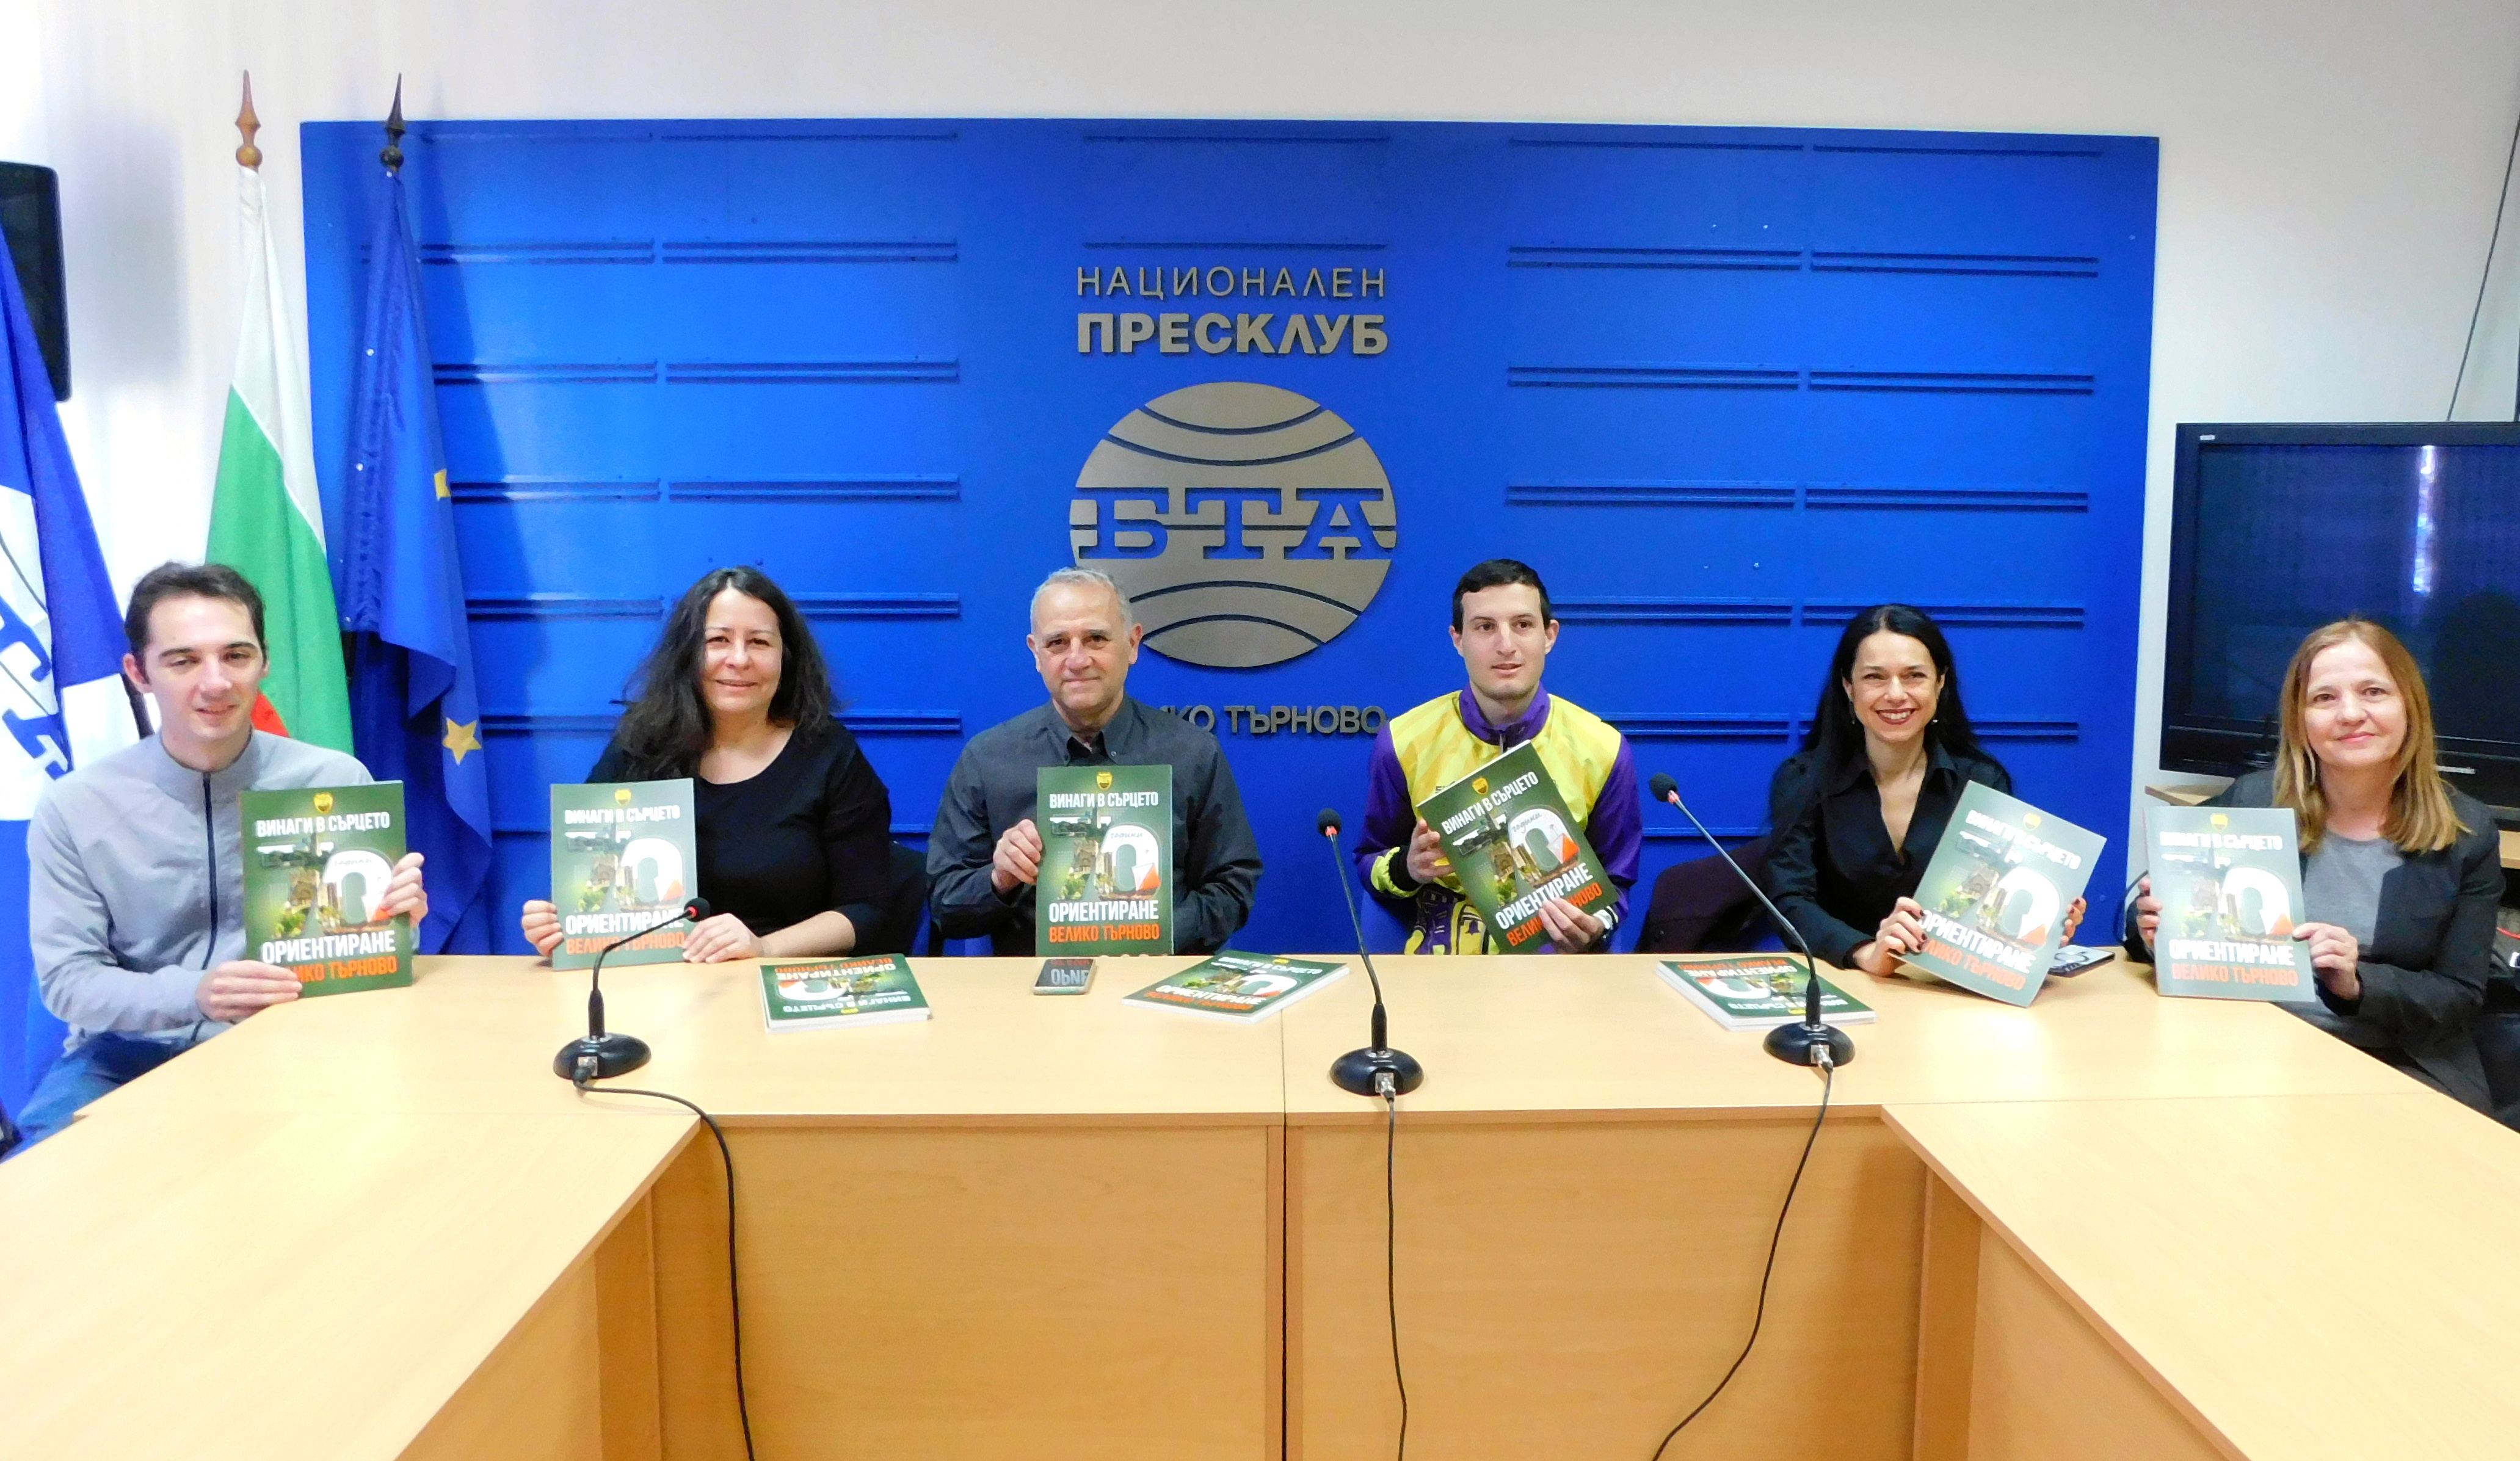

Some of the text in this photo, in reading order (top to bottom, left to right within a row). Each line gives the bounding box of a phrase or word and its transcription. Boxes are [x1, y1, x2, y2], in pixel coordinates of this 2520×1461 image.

[1077, 266, 1385, 300] НАЦИОНАЛЕН
[1077, 312, 1389, 355] ПРЕСКЛУБ
[1076, 487, 1395, 560] БТА
[1224, 705, 1387, 734] ТЪРНОВО
[1049, 791, 1159, 808] ВИНАГИ В СЪРЦЕТО
[1441, 771, 1539, 835] ВИНАГИ В СЪРЦЕТО
[256, 811, 390, 838] ВИНАГИ В СЪРЦЕТО
[565, 808, 614, 825] ВИНАГИ
[626, 805, 680, 823] СЪРЦЕТО
[1495, 862, 1594, 930] ОРИЕНТИРАНЕ
[565, 908, 684, 935] ОРИЕНТИРАНЕ
[1048, 900, 1160, 923] ОРИЕНТИРАНЕ
[1506, 882, 1603, 947] ВЕЛИ НОВО
[1049, 923, 1160, 943] ВЕЛИКО ТЪРНОВО
[1918, 910, 2037, 974] ОРИЕНТИРАНЕ
[261, 930, 396, 965] ОРИЕНТИРАНЕ
[2168, 939, 2296, 966] ОРИЕНТИРАНЕ
[294, 955, 398, 983] ИКО ТЪРНОВО
[775, 963, 896, 981] ОРИЕНТИРАНЕ
[1923, 938, 2027, 991] ЛИКО ТЪРНОВО
[2172, 963, 2299, 987] ВЕЛИКО ТЪРНОВО
